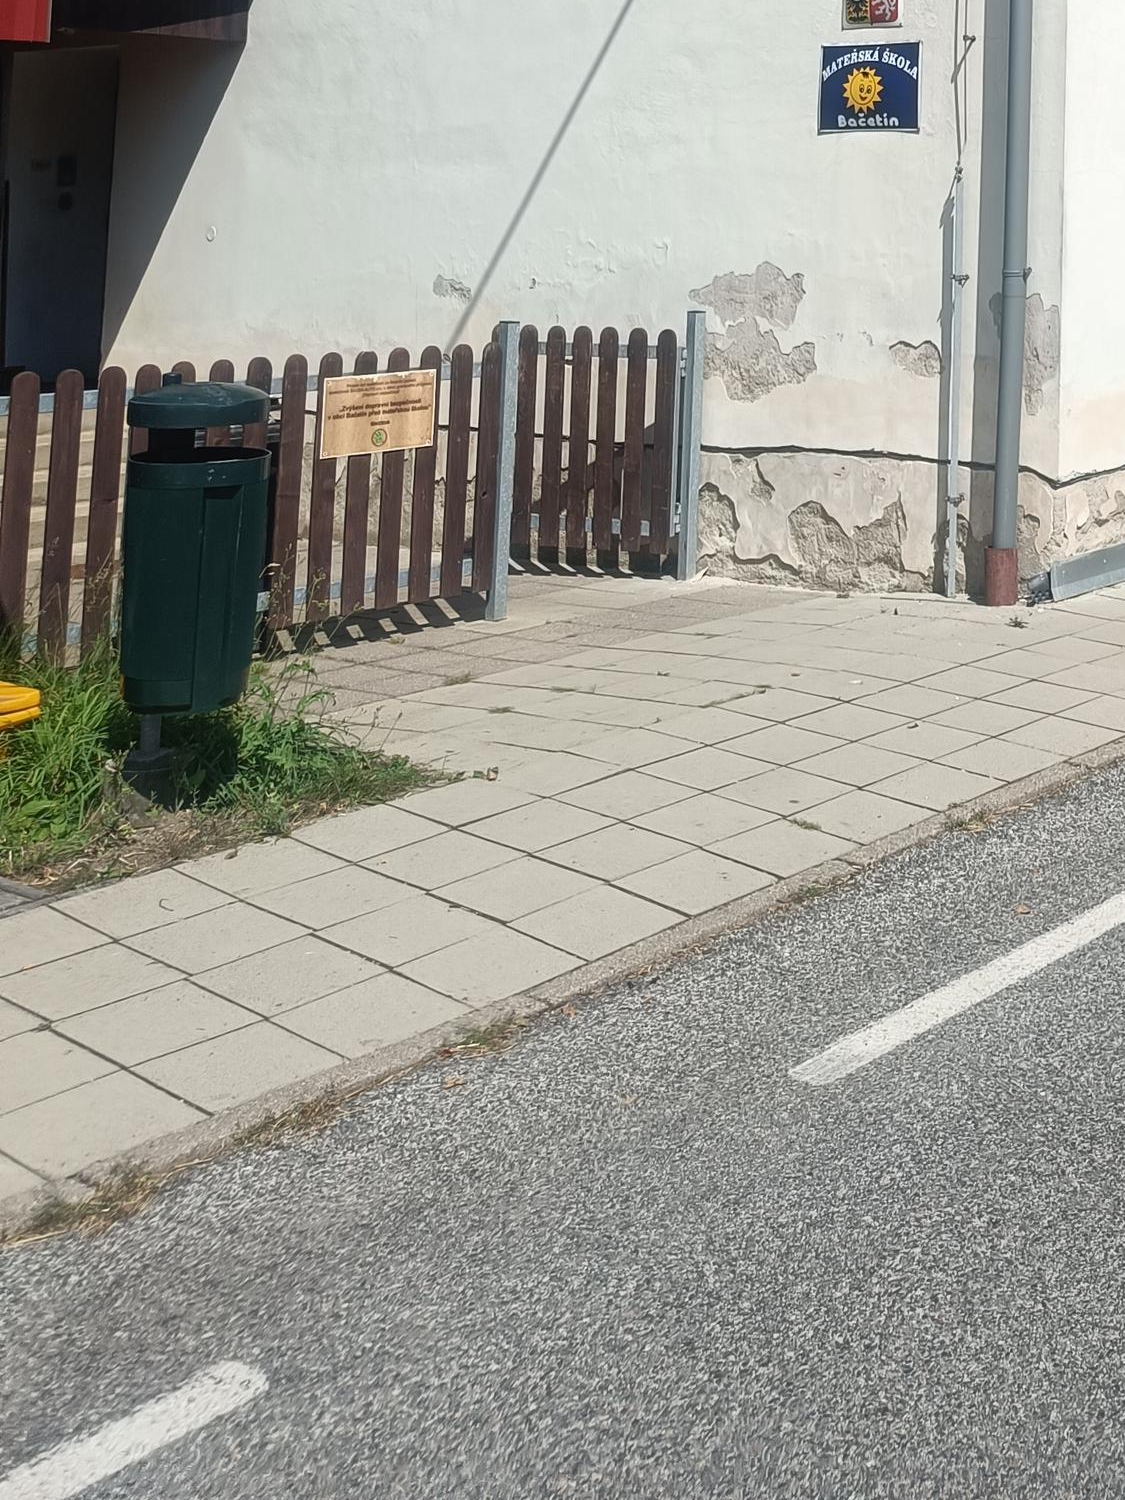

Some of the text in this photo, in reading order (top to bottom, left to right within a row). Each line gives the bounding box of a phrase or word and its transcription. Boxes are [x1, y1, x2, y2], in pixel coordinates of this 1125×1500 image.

[822, 46, 918, 82] MATEŘSKÁ ŠKOLA
[837, 113, 899, 127] Bačetín
